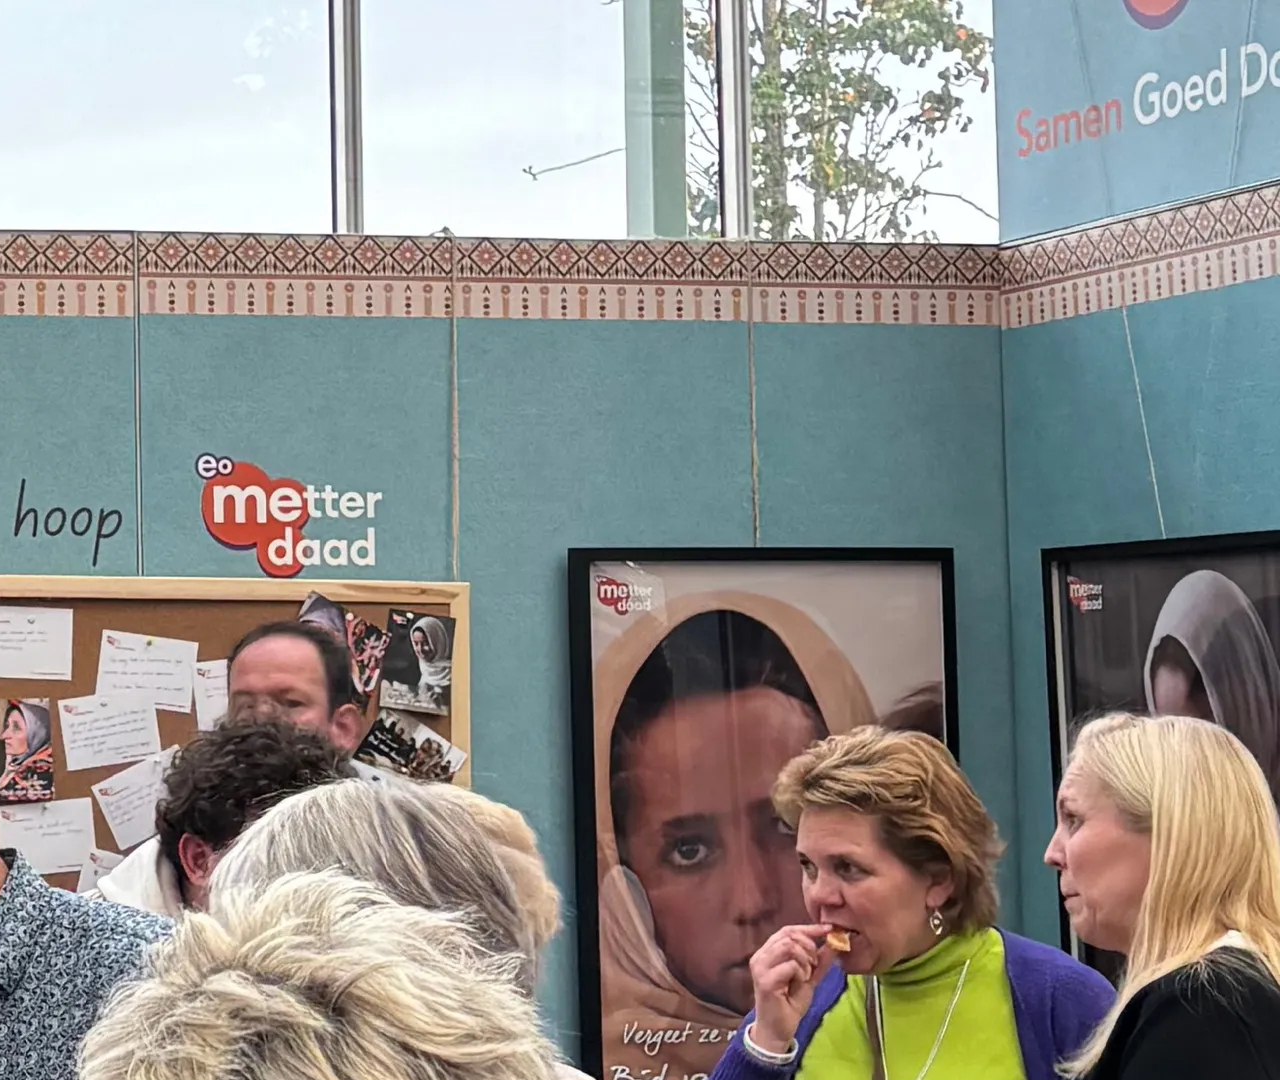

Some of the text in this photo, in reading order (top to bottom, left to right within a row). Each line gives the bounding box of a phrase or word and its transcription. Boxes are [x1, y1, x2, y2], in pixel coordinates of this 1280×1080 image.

[1015, 98, 1122, 158] Samen
[1133, 47, 1227, 125] Goed
[196, 453, 234, 480] eo
[14, 478, 123, 567] hoop
[213, 484, 383, 524] metter
[267, 526, 376, 566] daad
[623, 1021, 693, 1056] Vergeet
[698, 1028, 723, 1043] ze
